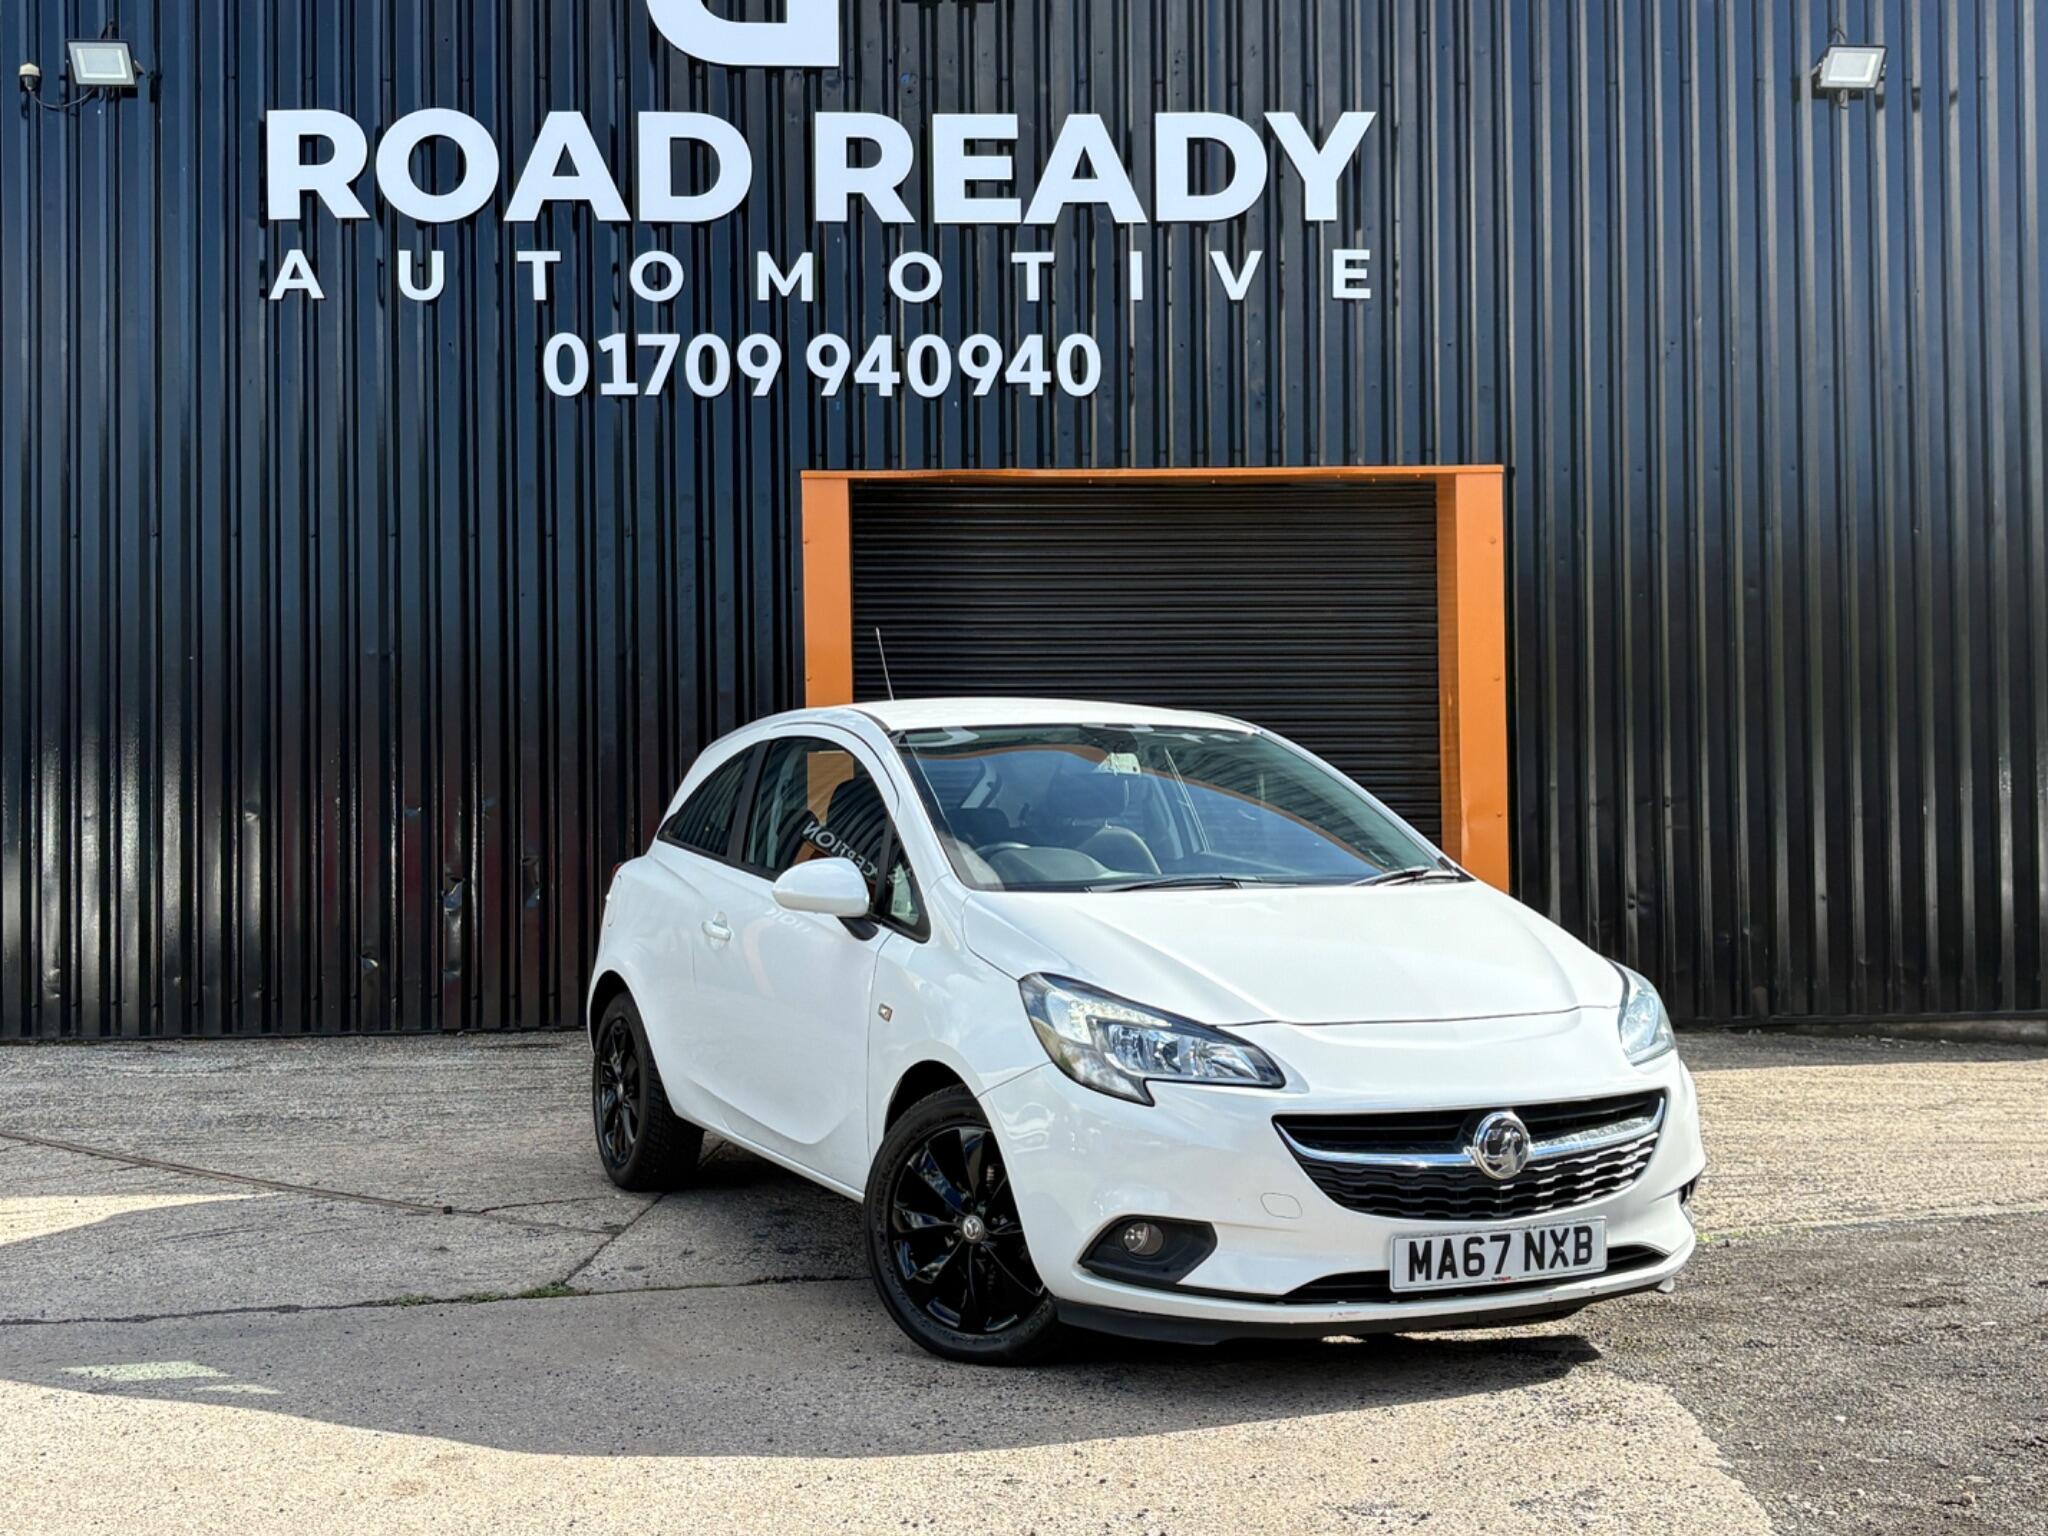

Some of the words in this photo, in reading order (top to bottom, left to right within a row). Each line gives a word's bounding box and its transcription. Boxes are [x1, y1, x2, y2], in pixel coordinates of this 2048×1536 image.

[266, 108, 753, 223] ROAD
[814, 110, 1376, 225] READY
[268, 248, 1372, 302] AUTOMOTIVE
[542, 332, 782, 398] 01709
[805, 332, 1102, 398] 940940
[1408, 1233, 1511, 1282] MA67
[1523, 1225, 1594, 1272] NXB
